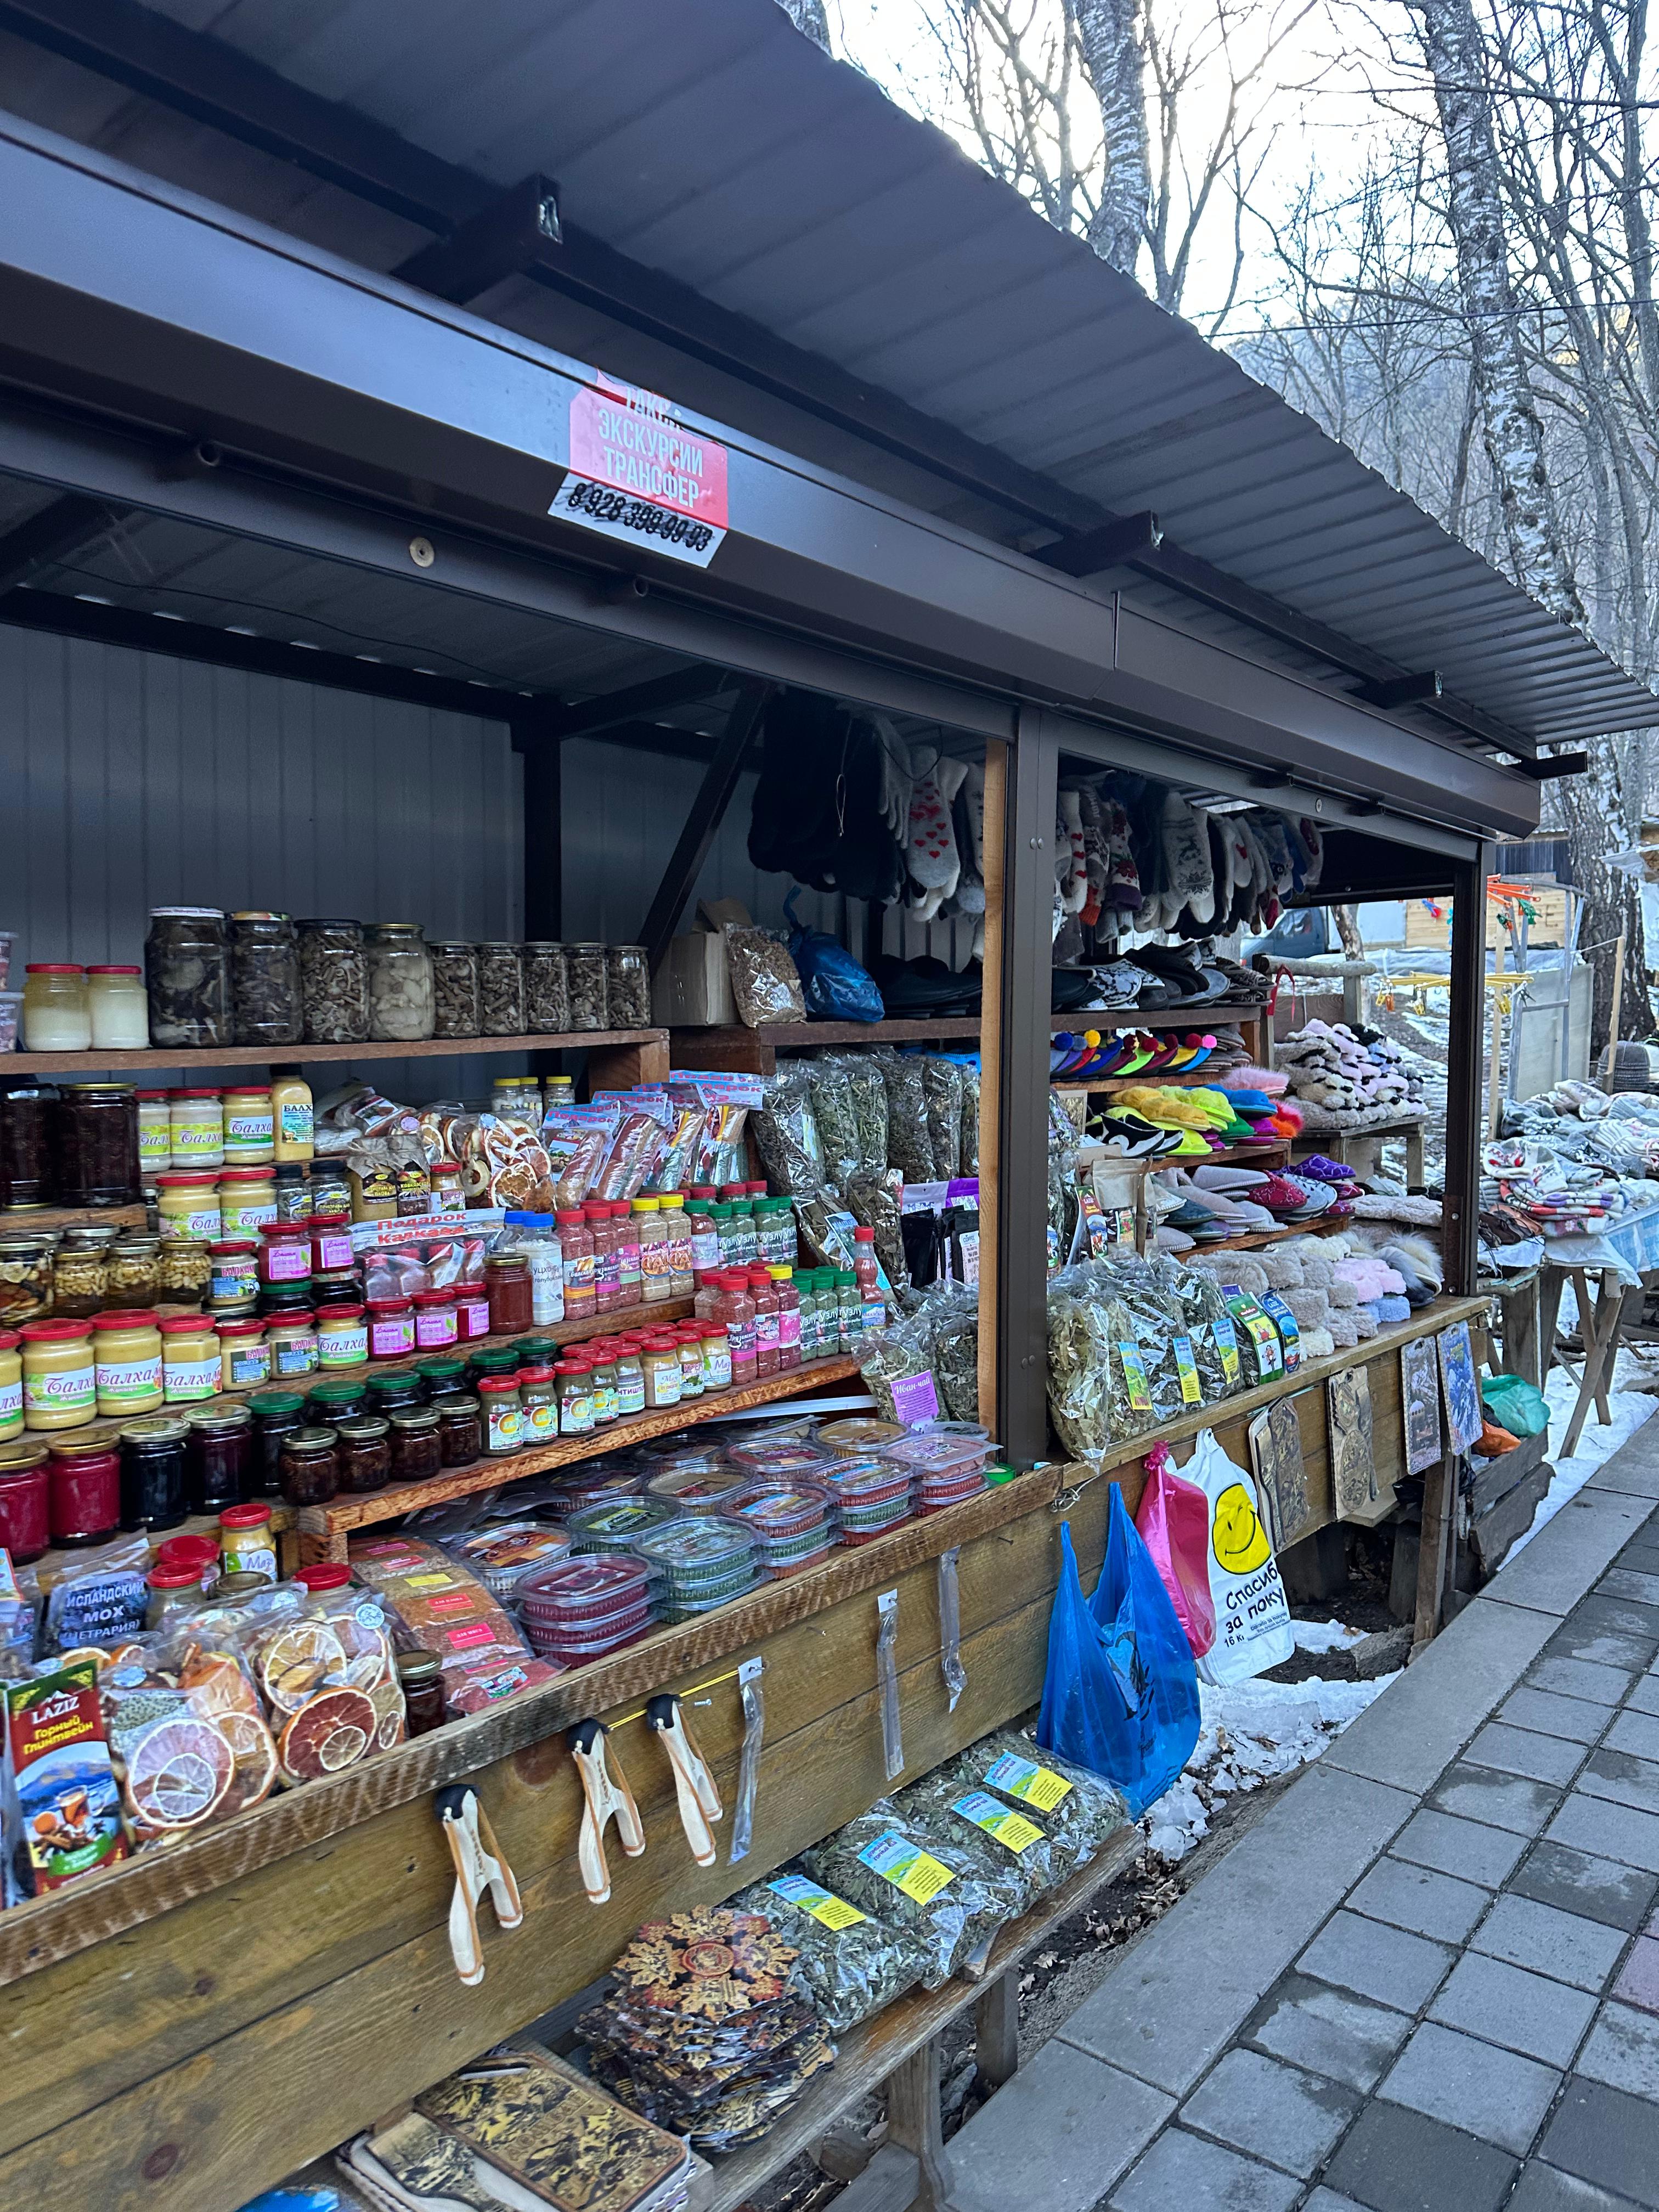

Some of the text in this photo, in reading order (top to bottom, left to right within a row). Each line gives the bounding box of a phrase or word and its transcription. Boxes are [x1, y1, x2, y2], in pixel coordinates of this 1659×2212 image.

[598, 409, 703, 478] ЭКСКУРСИИ
[603, 445, 699, 508] ТРАНСФЕР
[377, 1213, 466, 1231] Подарок
[377, 1225, 465, 1245] Кавказа
[894, 1376, 930, 1395] Иван-чай
[1226, 1561, 1278, 1610] Спасиб
[83, 1605, 125, 1623] МОХ
[1226, 1616, 1244, 1634] за
[1248, 1587, 1285, 1620] поку
[1224, 1636, 1235, 1648] 16
[32, 1696, 80, 1725] LAZIZ
